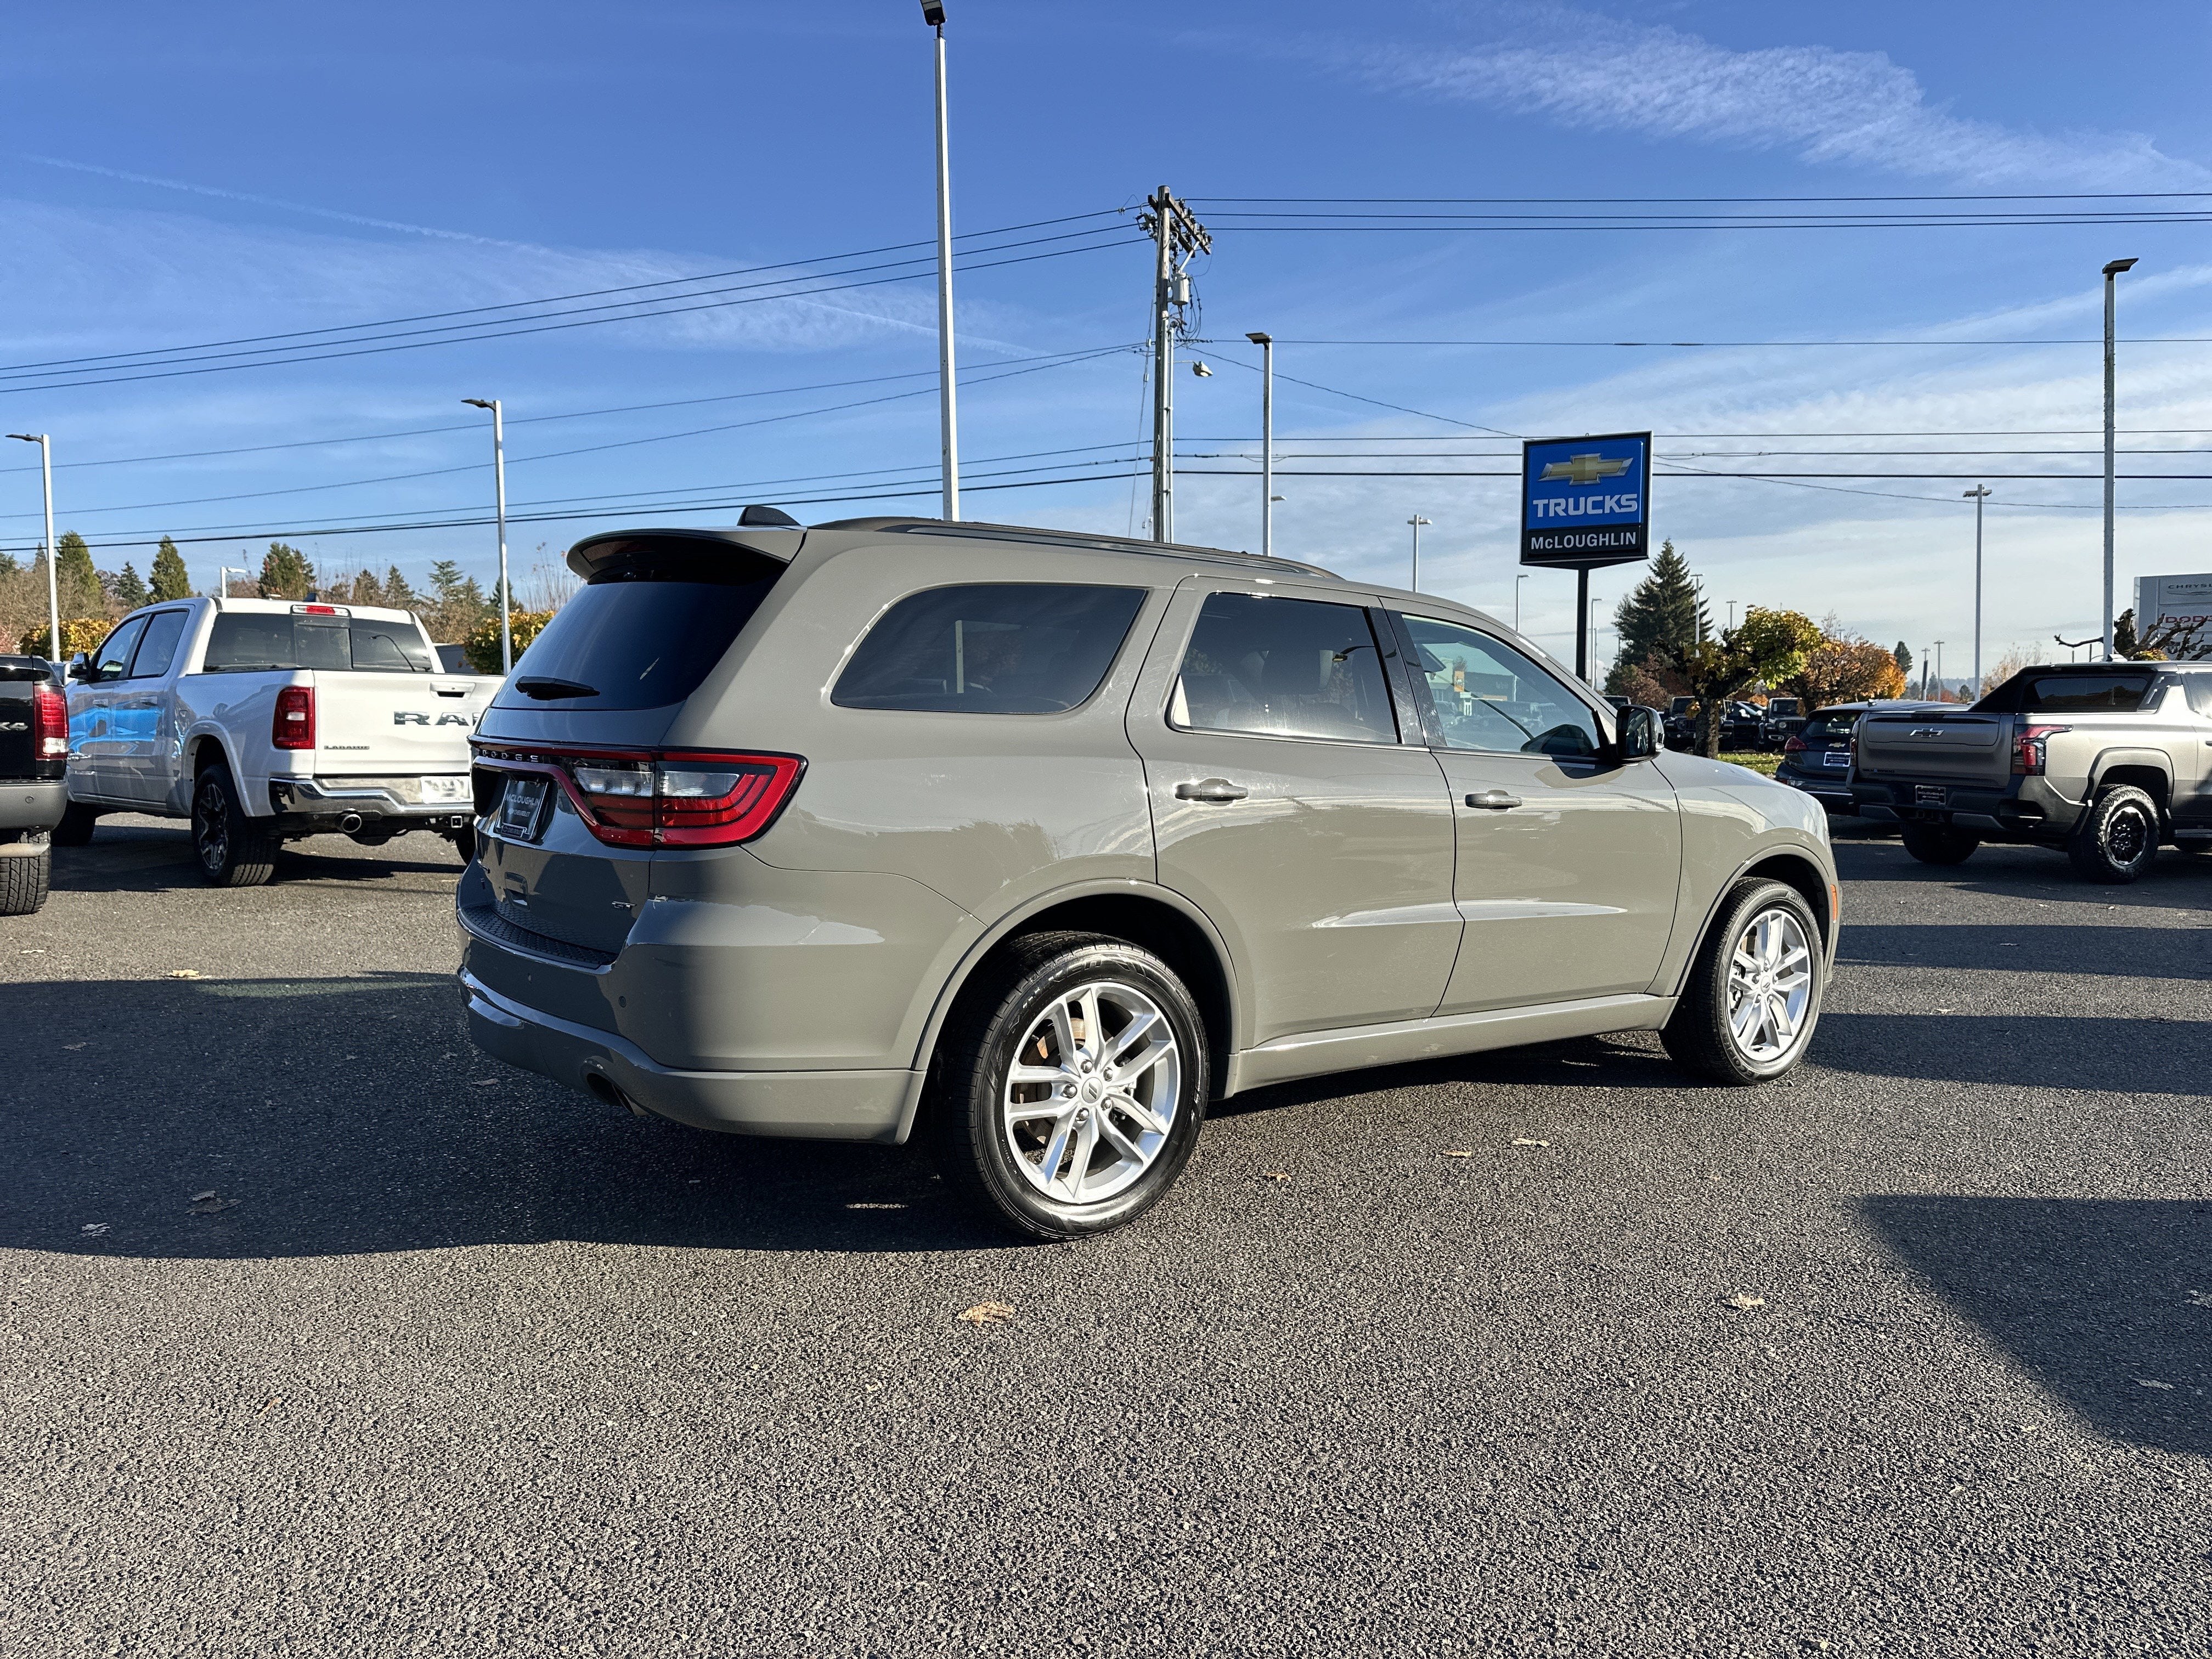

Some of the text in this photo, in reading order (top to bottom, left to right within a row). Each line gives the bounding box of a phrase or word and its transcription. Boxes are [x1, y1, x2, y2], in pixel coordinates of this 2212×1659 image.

[1533, 493, 1638, 518] TRUCKS
[1531, 532, 1636, 550] McLOUGHLIN
[482, 749, 539, 763] DODGE
